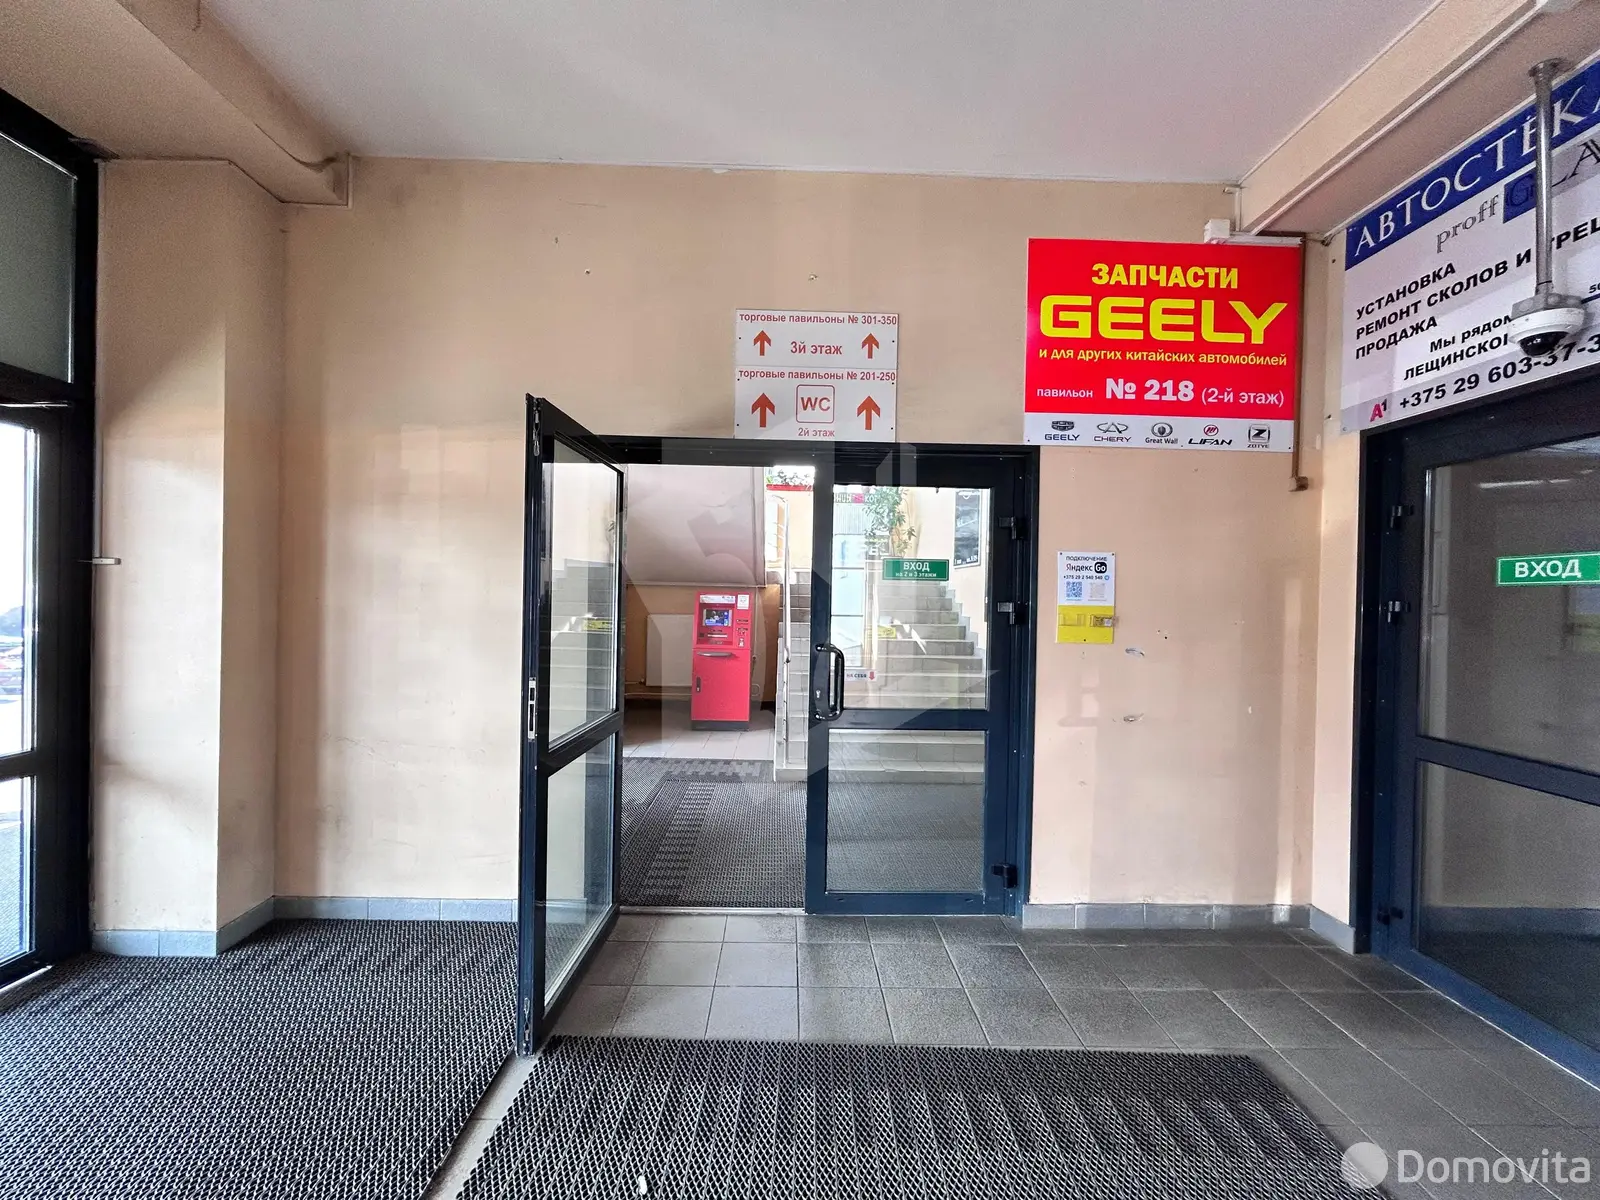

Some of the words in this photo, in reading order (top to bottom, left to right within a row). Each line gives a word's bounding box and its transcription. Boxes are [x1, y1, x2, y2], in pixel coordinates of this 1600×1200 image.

[1355, 85, 1600, 256] АВТОСТЁК
[1436, 193, 1499, 254] proff
[1092, 263, 1238, 289] ЗАПЧАСТИ
[1356, 300, 1421, 340] РЕМОНТ
[1427, 260, 1508, 307] СКОЛОВ
[1516, 249, 1532, 268] И
[1550, 217, 1600, 250] РЕ
[1356, 263, 1456, 320] УСТАНОВКА
[739, 313, 786, 323] торговые
[789, 315, 845, 324] павильоны
[848, 315, 858, 324] №
[861, 315, 897, 325] 301-350
[1040, 295, 1288, 344] GEELY
[1355, 316, 1438, 360] ПРОДАЖА
[1430, 336, 1456, 353] Мы
[790, 341, 806, 354] 3й
[811, 344, 842, 355] этаж
[1039, 350, 1047, 358] и
[1050, 350, 1074, 360] для
[1077, 350, 1122, 363] других
[1126, 351, 1195, 363] китайских
[1198, 353, 1287, 366] автомобилей
[739, 370, 785, 379] торговые
[788, 371, 844, 380] павильоны
[847, 372, 857, 380] №
[860, 372, 896, 381] 201-250
[1036, 387, 1093, 398] павильон
[1105, 378, 1136, 400] №
[1144, 379, 1195, 402] 218
[1201, 387, 1234, 405] (2-й
[1239, 390, 1285, 408] этаж)
[1400, 383, 1447, 408] +375
[1453, 373, 1480, 395] 29
[801, 397, 830, 411] WC
[798, 428, 810, 437] 2й
[812, 429, 835, 437] этаж
[1044, 433, 1080, 441] GEELY
[1094, 435, 1132, 443] CHERY
[1164, 437, 1178, 445] Wall
[1188, 438, 1233, 446] LIFAN
[903, 562, 930, 571] ВХОД
[1066, 563, 1093, 572] Яндекс
[1095, 563, 1106, 572] Go
[1515, 559, 1582, 578] ВХОД
